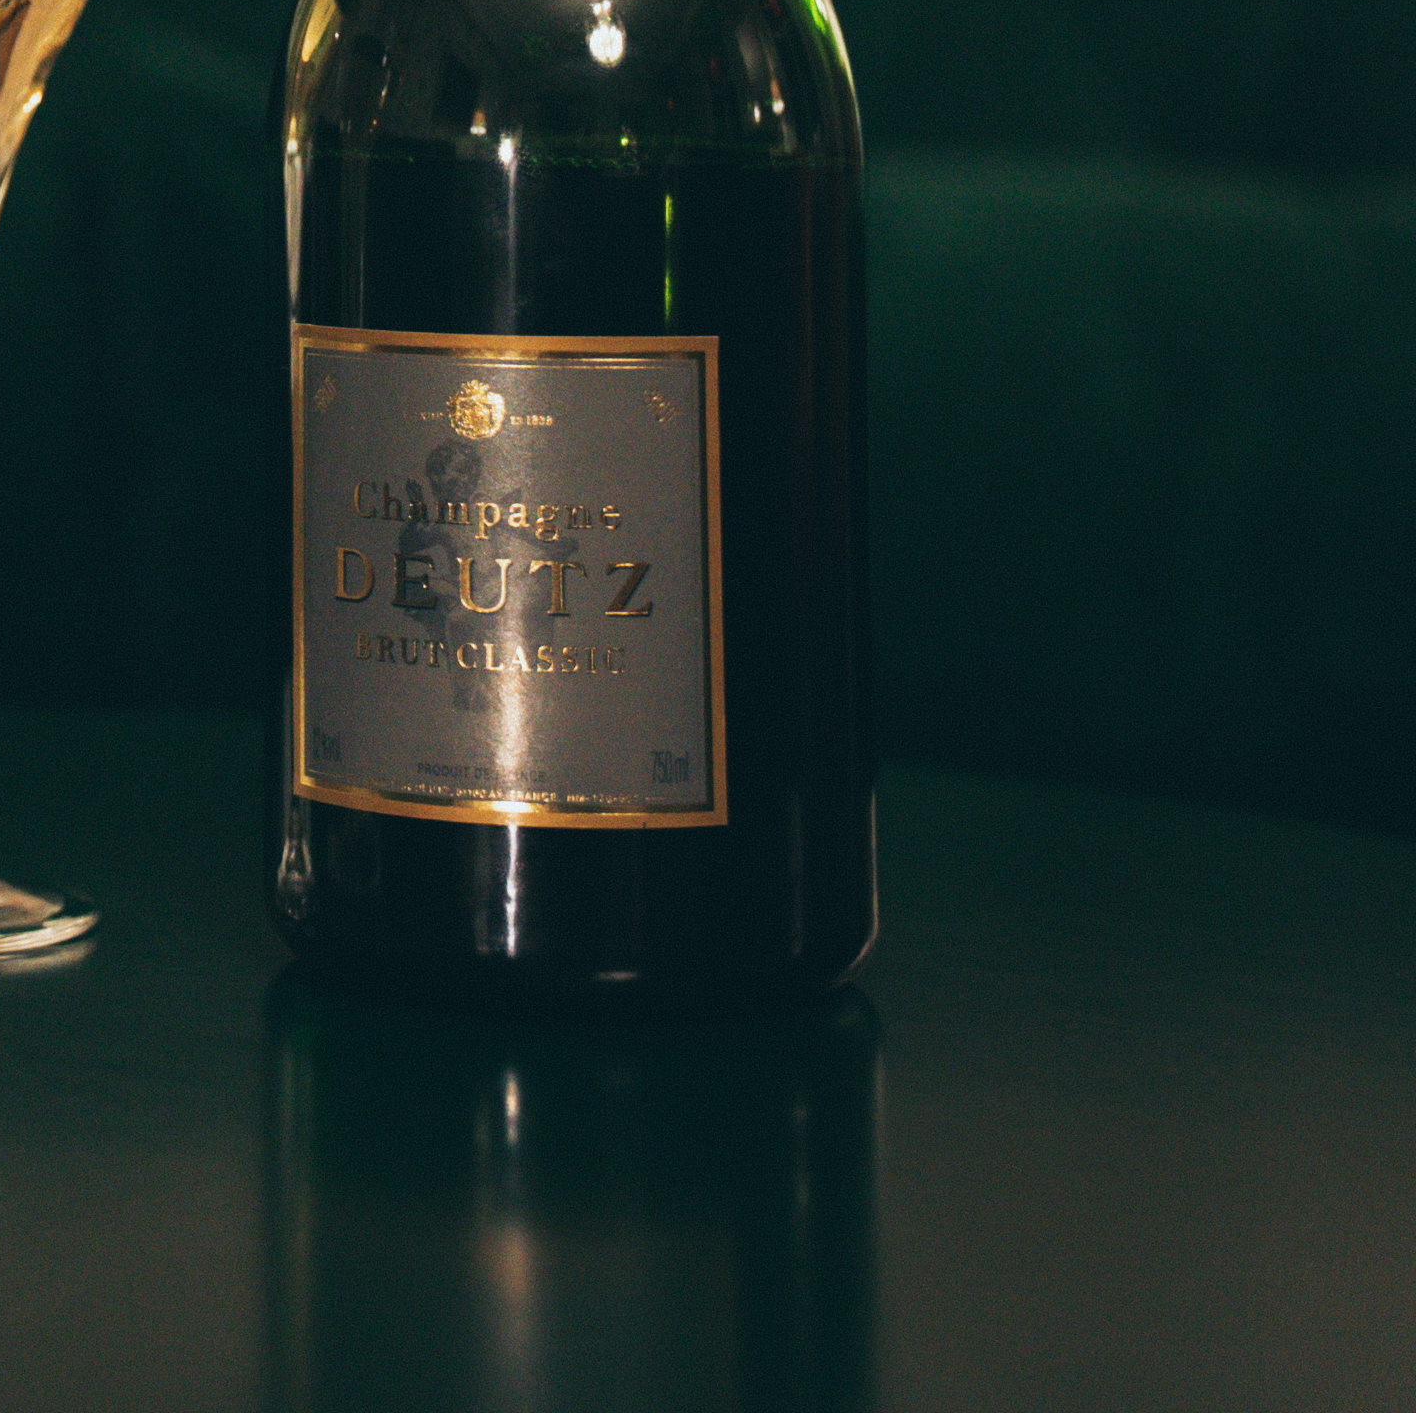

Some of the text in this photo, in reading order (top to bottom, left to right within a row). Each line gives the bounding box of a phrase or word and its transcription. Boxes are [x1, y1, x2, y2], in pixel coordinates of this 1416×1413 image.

[353, 478, 621, 542] Champagne
[335, 546, 652, 617] DEUTZ
[355, 632, 625, 674] BRUT CLASSIC
